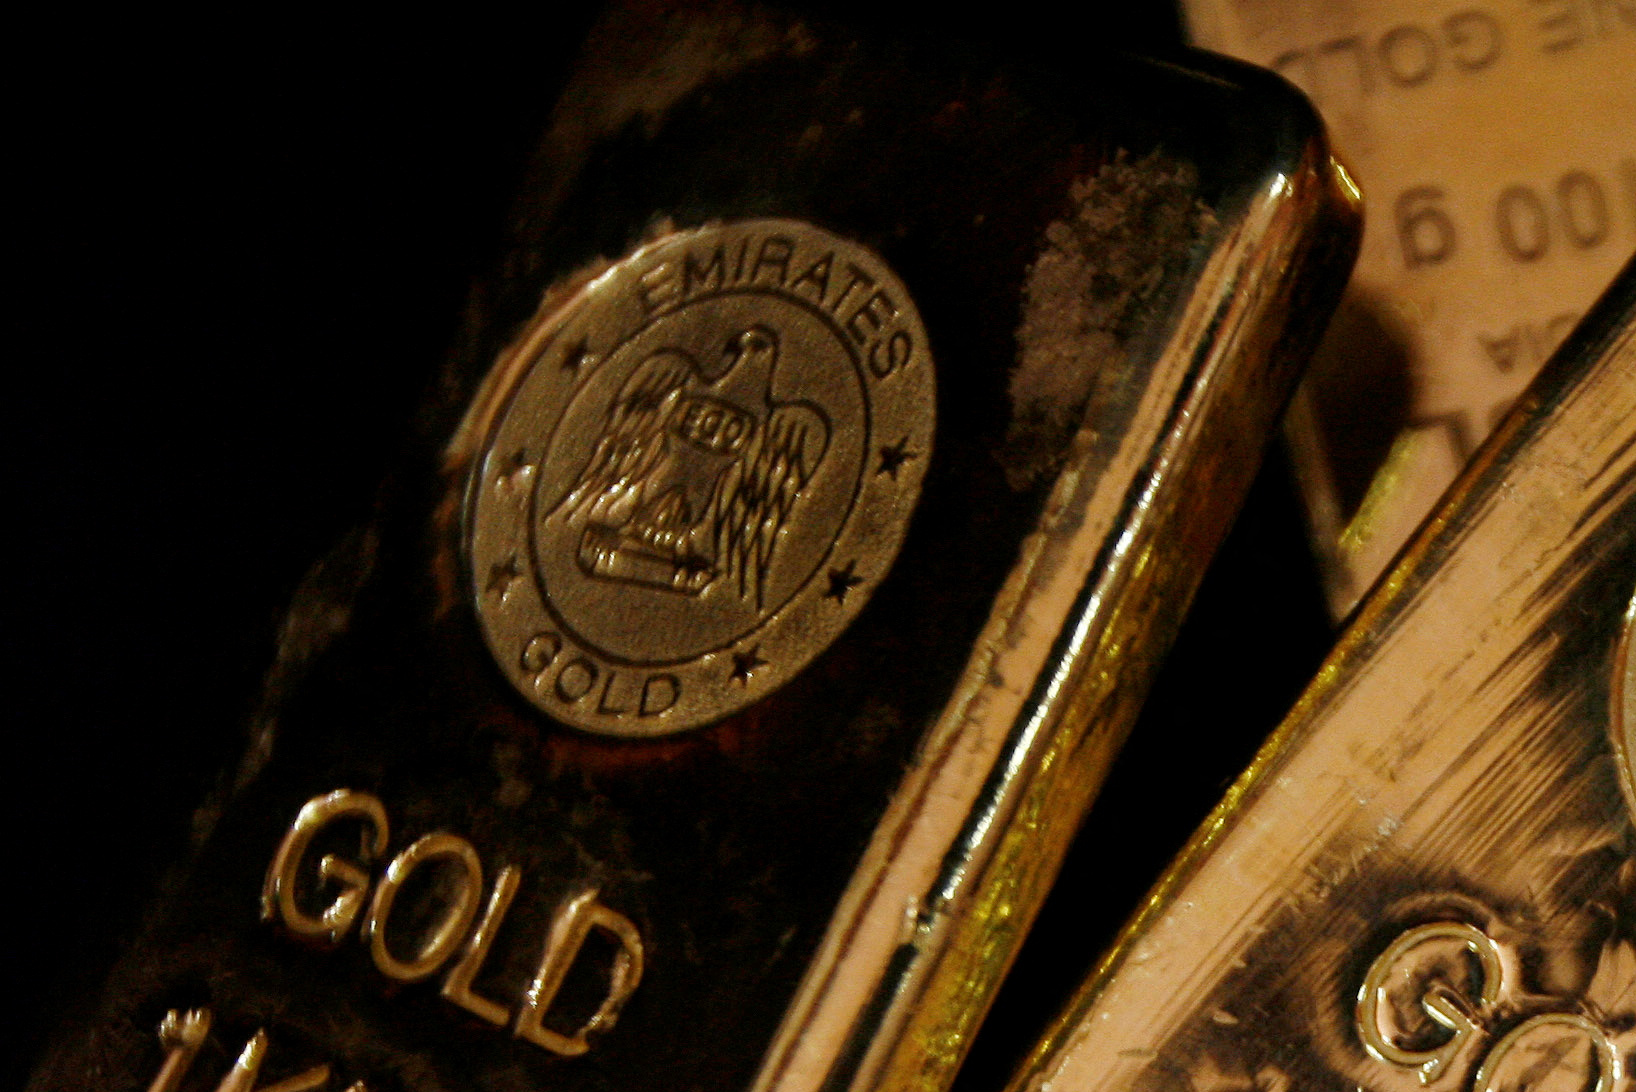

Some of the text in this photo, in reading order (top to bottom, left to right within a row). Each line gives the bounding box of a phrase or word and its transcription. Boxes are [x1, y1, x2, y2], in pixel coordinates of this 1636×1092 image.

[637, 232, 914, 382] EMIRATES
[517, 629, 682, 718] GOLD
[260, 787, 645, 1057] GOLD
